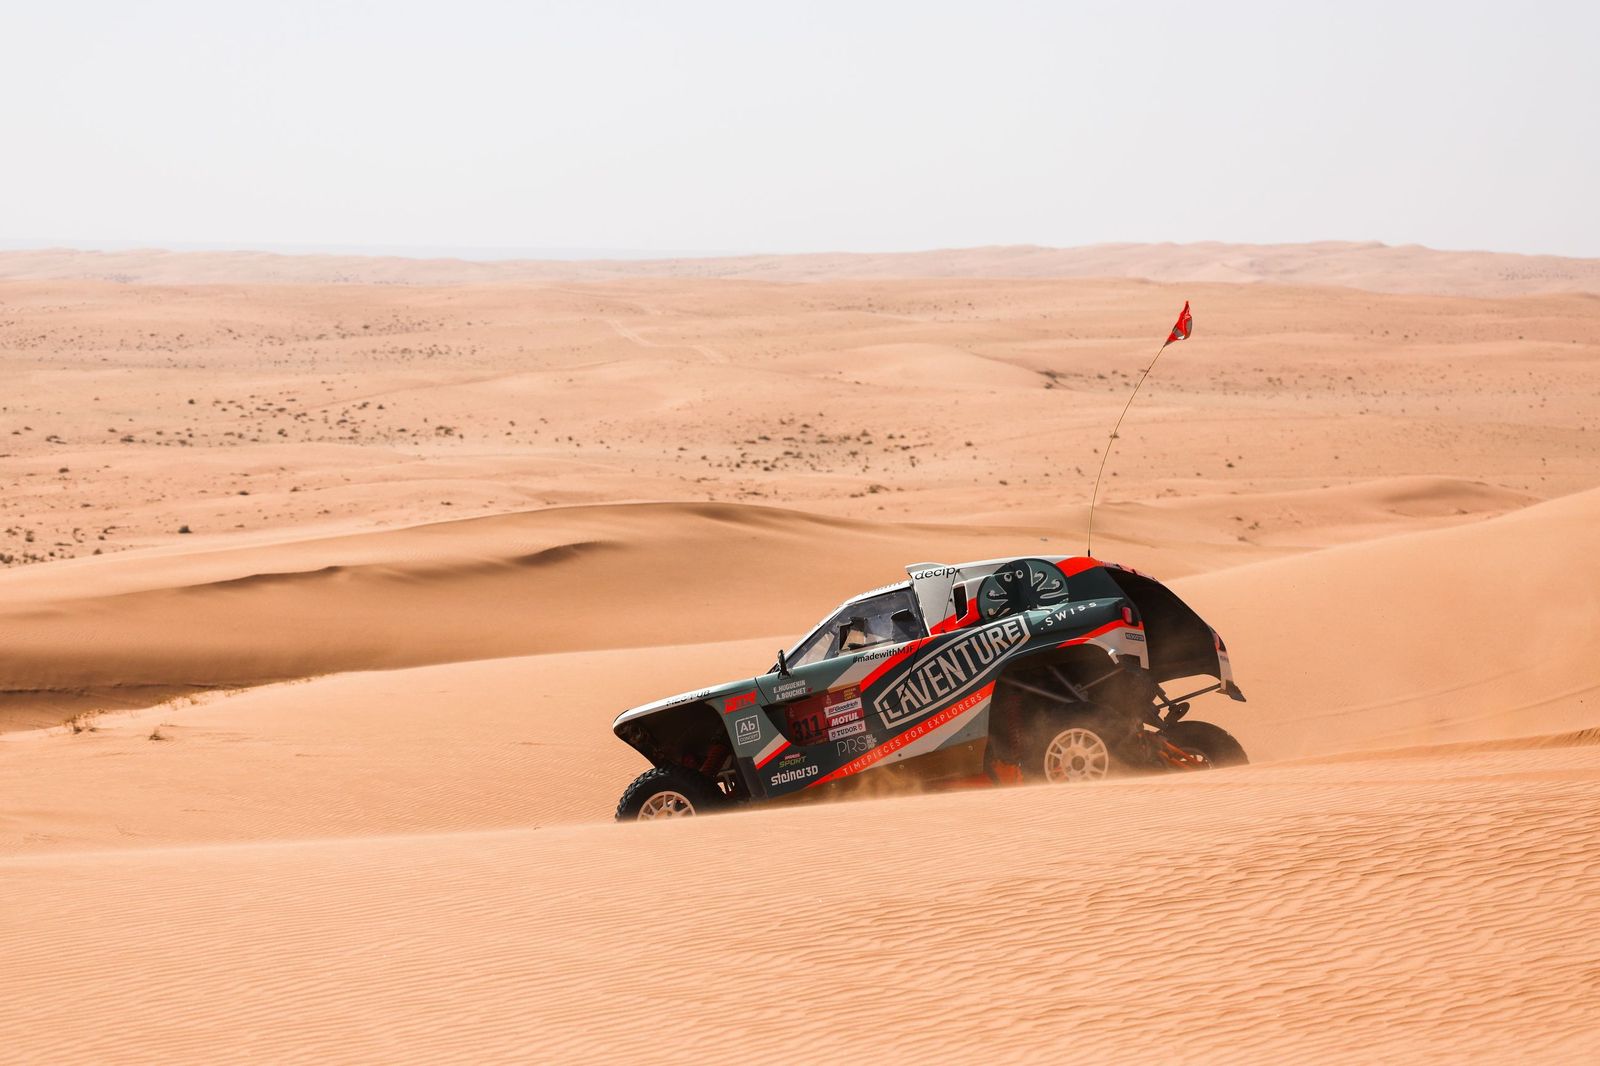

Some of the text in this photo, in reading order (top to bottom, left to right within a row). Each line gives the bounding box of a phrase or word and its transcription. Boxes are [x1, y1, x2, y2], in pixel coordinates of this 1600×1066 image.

[914, 567, 956, 580] decip
[831, 712, 859, 727] MOTUL
[740, 721, 756, 733] Ab
[836, 725, 858, 736] TUDOR
[842, 739, 901, 775] TIMEPIECES
[905, 727, 924, 742] FOR
[927, 693, 983, 729] EXPLORERS
